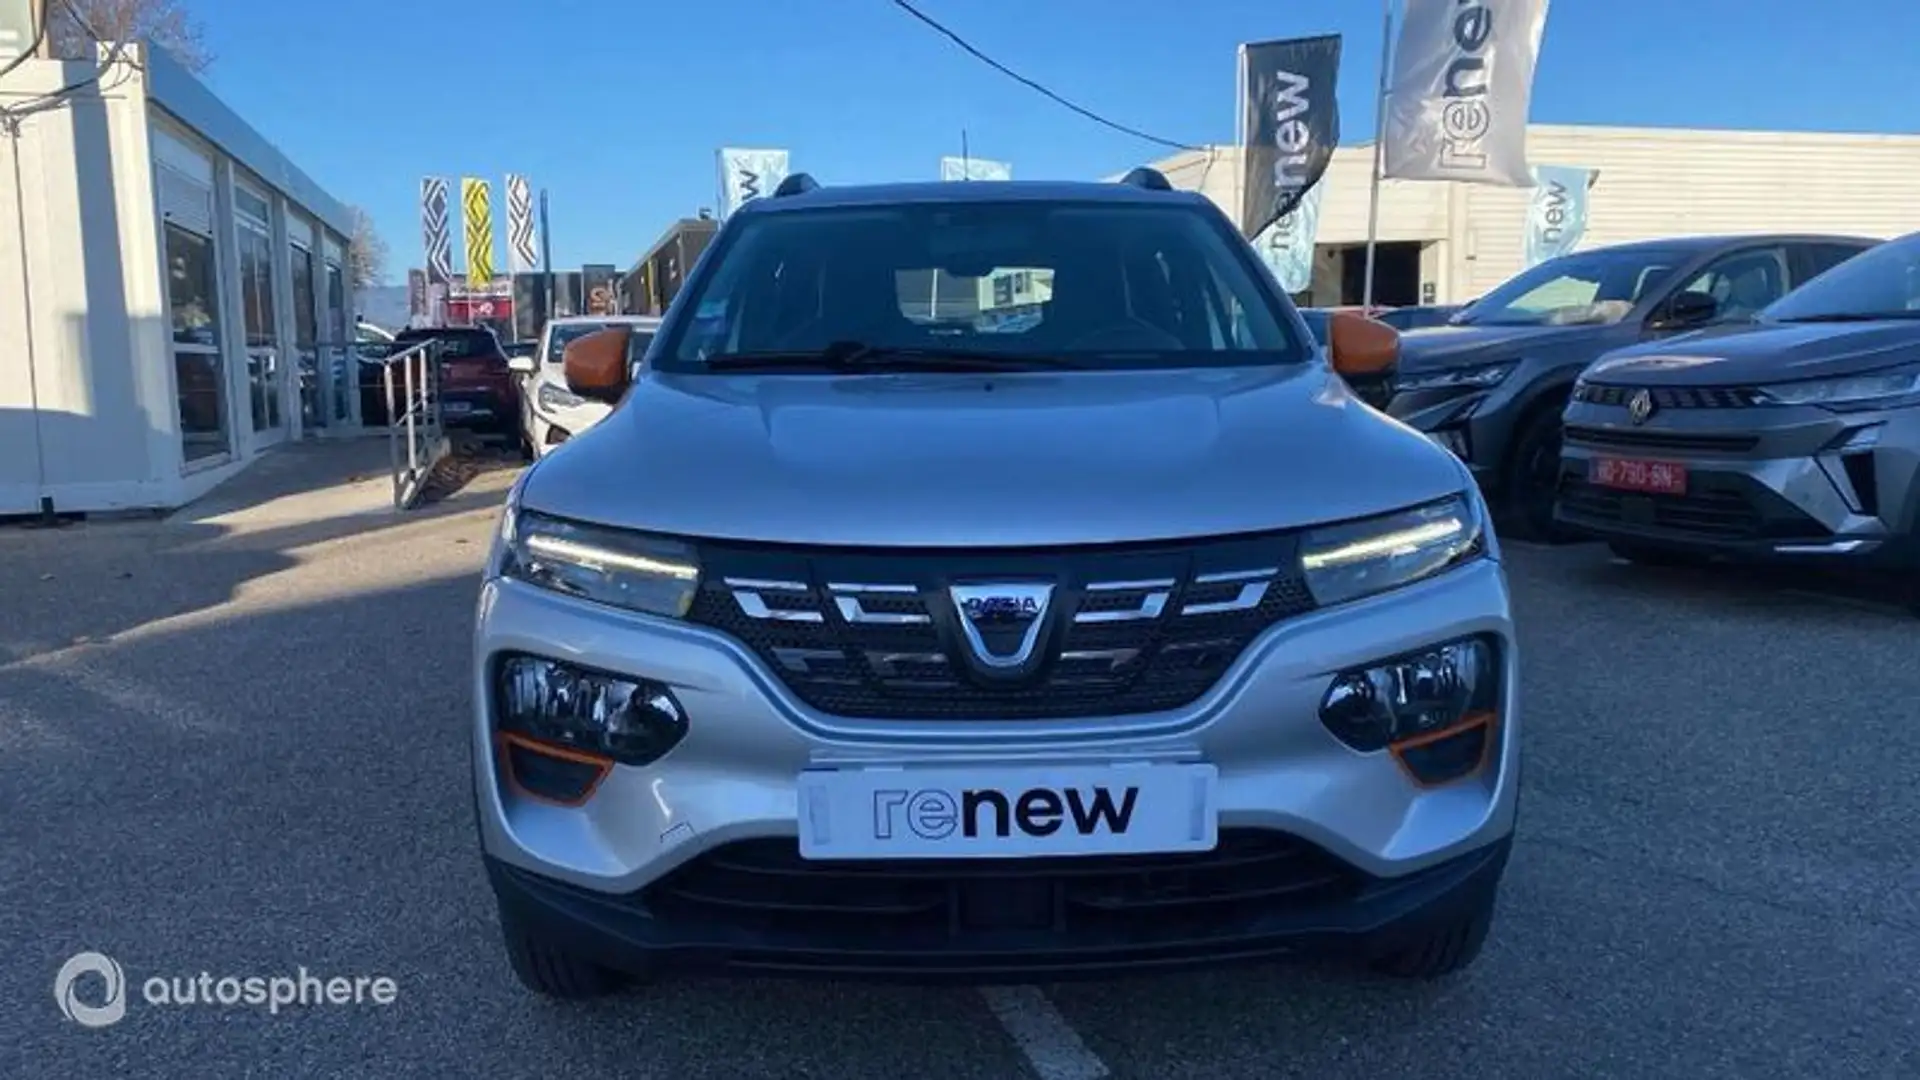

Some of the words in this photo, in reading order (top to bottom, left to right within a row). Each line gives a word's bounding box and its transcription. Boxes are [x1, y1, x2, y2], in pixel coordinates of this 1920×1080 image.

[1439, 0, 1491, 170] rene
[1542, 179, 1568, 245] new
[873, 786, 1140, 840] renew
